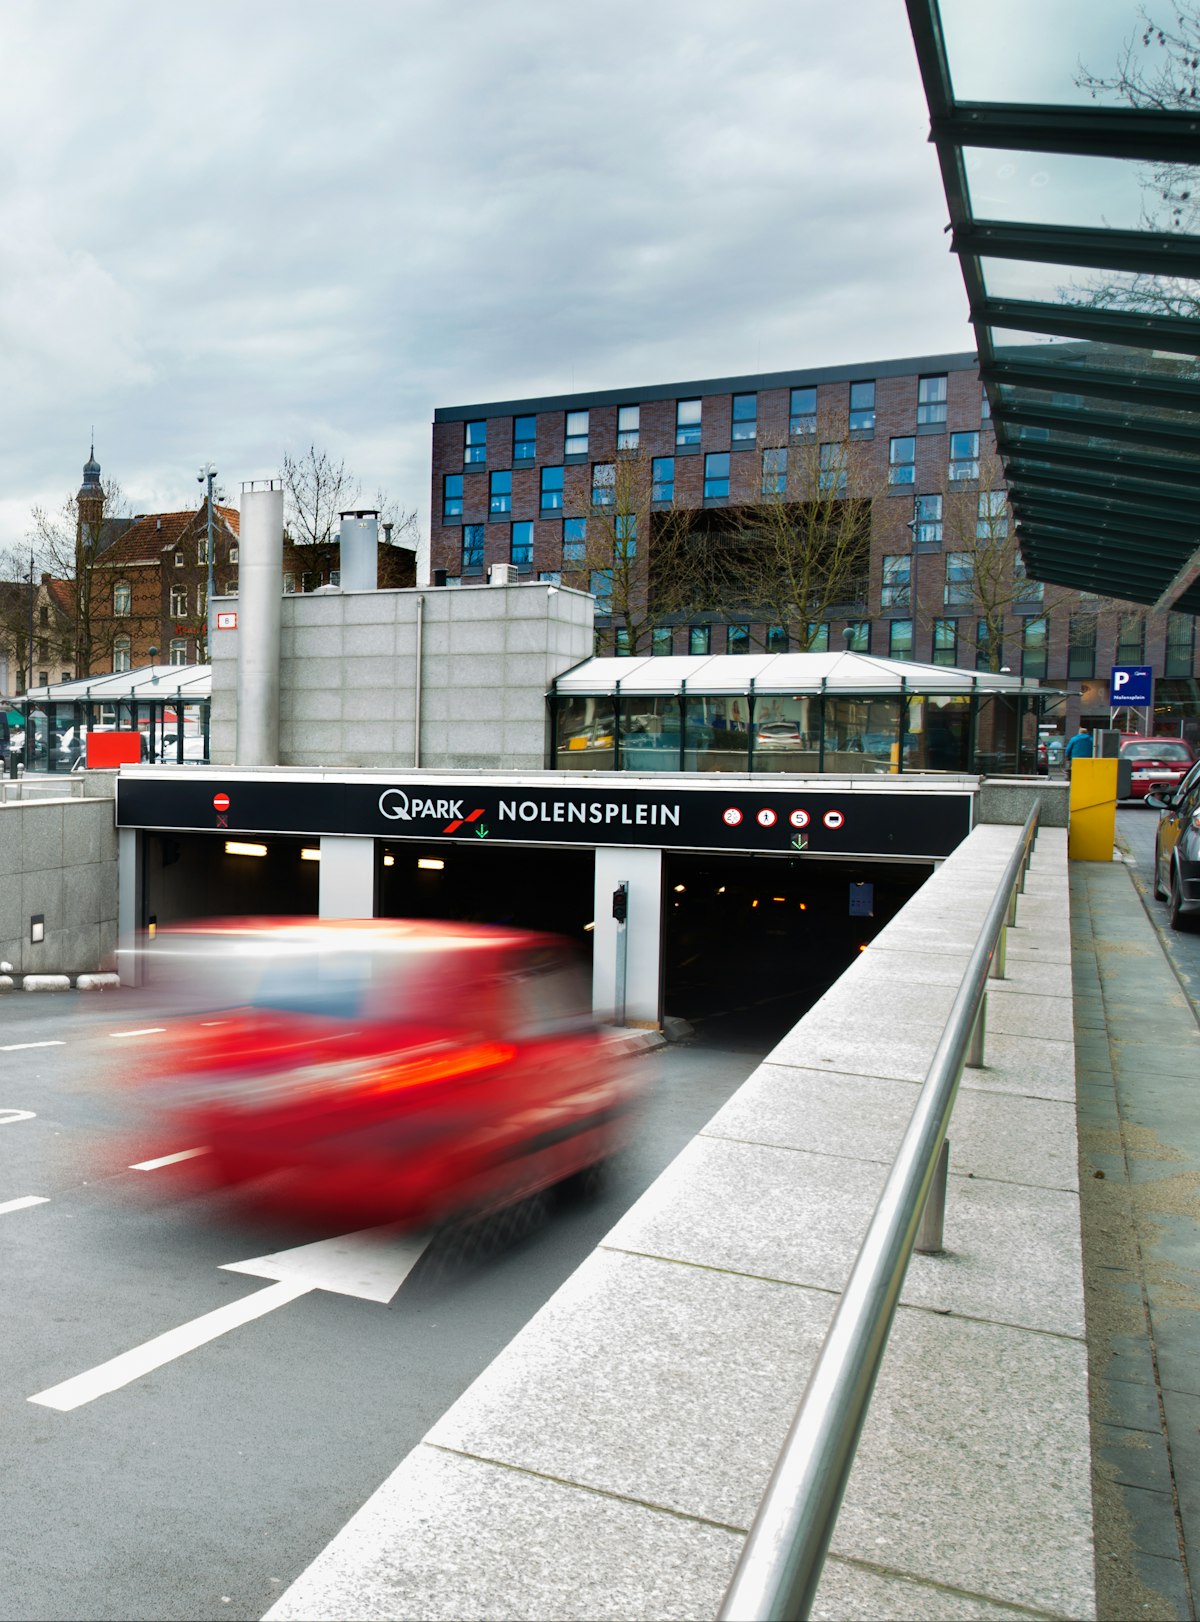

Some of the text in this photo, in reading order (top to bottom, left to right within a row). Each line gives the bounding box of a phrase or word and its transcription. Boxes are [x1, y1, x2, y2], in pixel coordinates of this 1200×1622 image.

[1114, 671, 1130, 691] P
[498, 800, 680, 826] NOLENSPLEIN
[795, 814, 804, 824] 5
